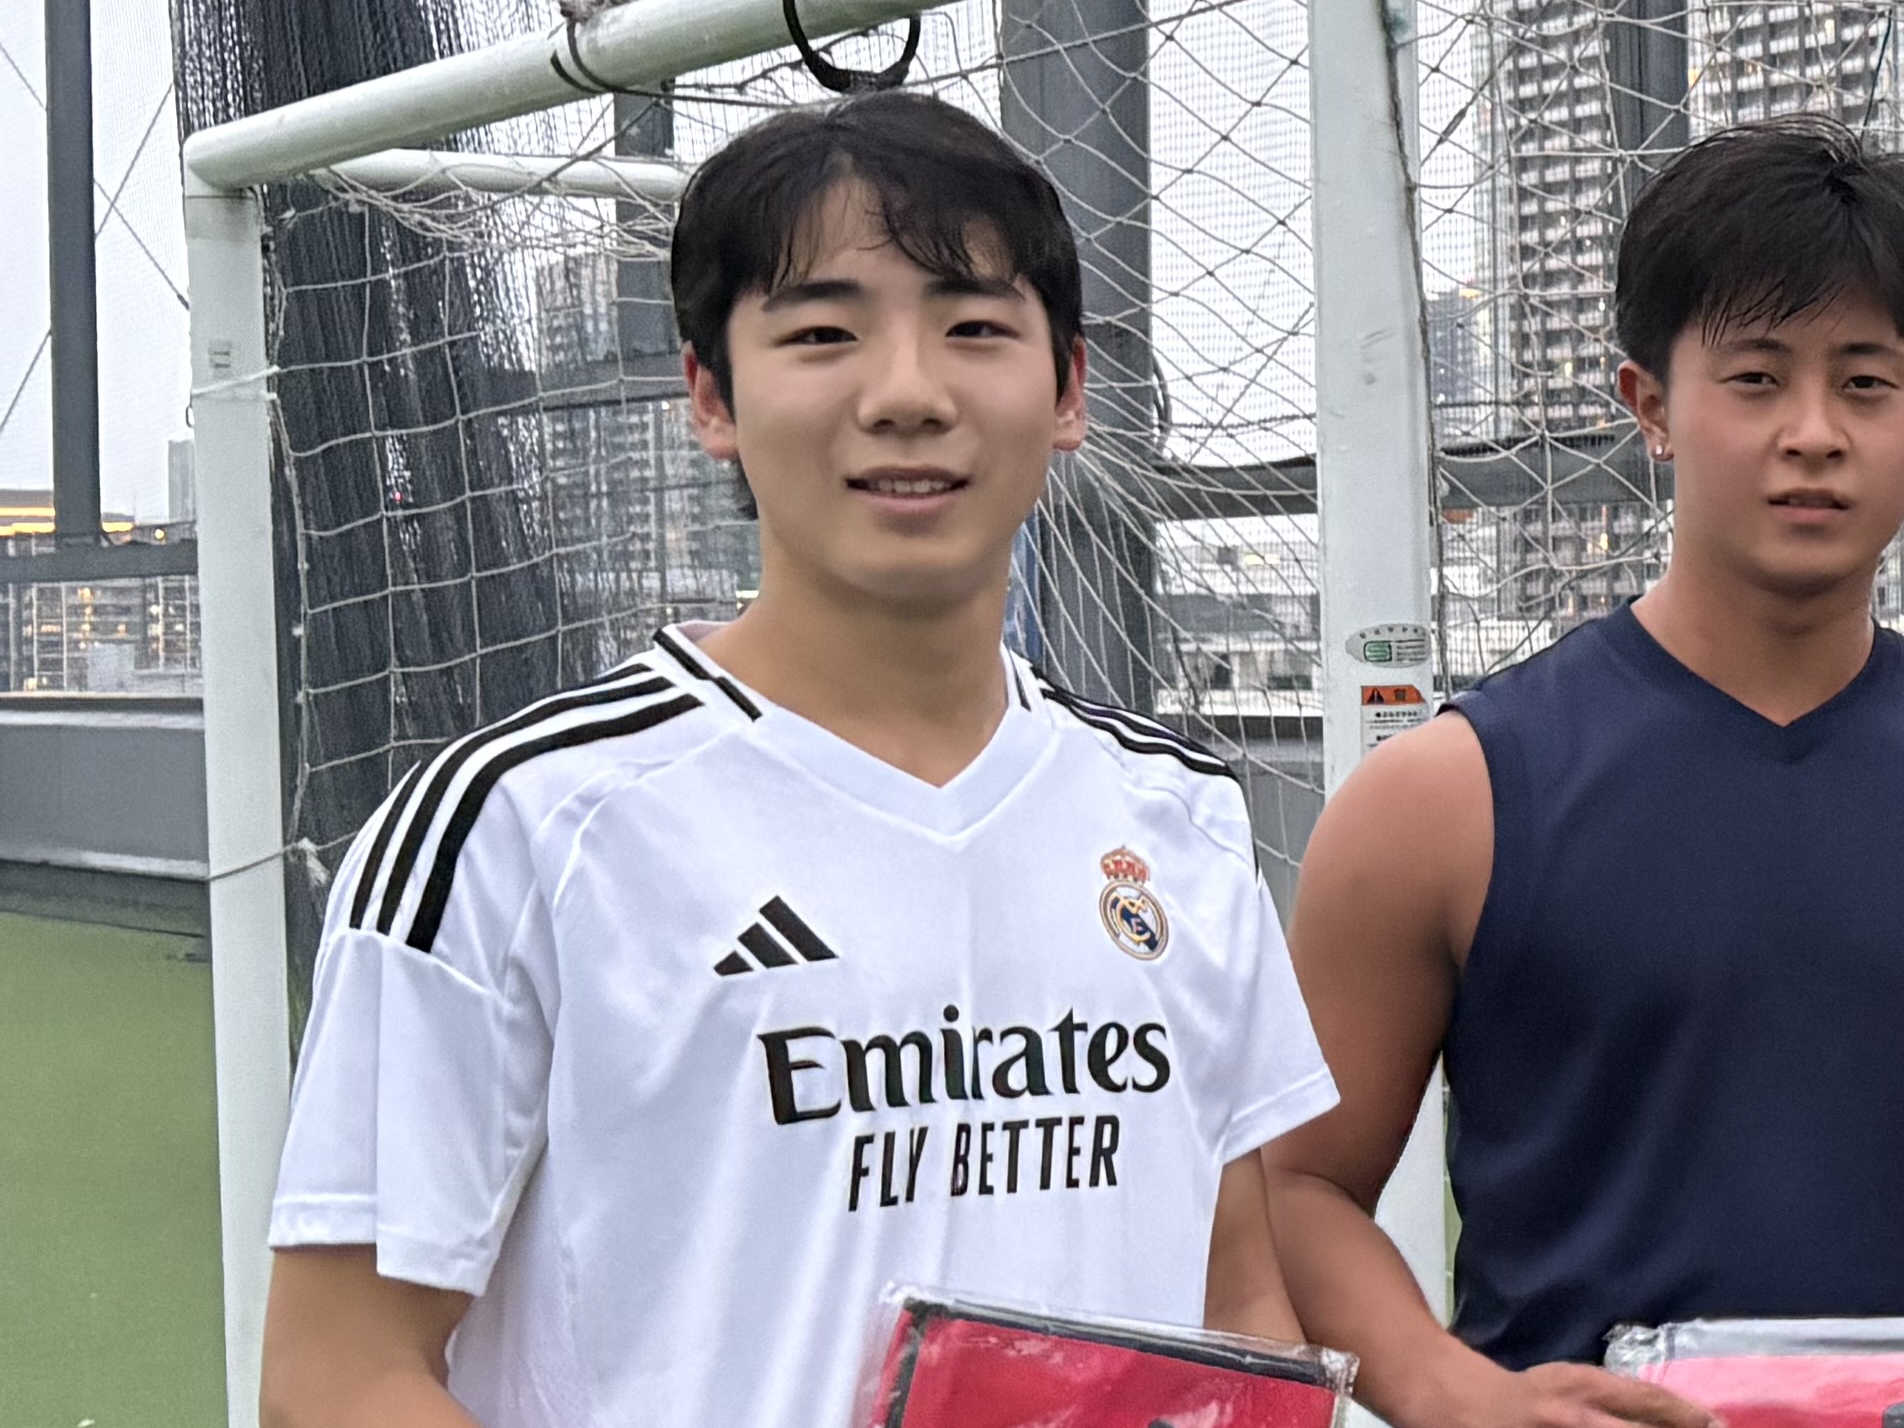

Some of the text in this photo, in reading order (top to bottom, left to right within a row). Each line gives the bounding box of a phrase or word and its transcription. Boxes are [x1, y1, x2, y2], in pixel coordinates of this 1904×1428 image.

[757, 1004, 1171, 1126] Emirates
[848, 1115, 1120, 1212] FLY BETTER
